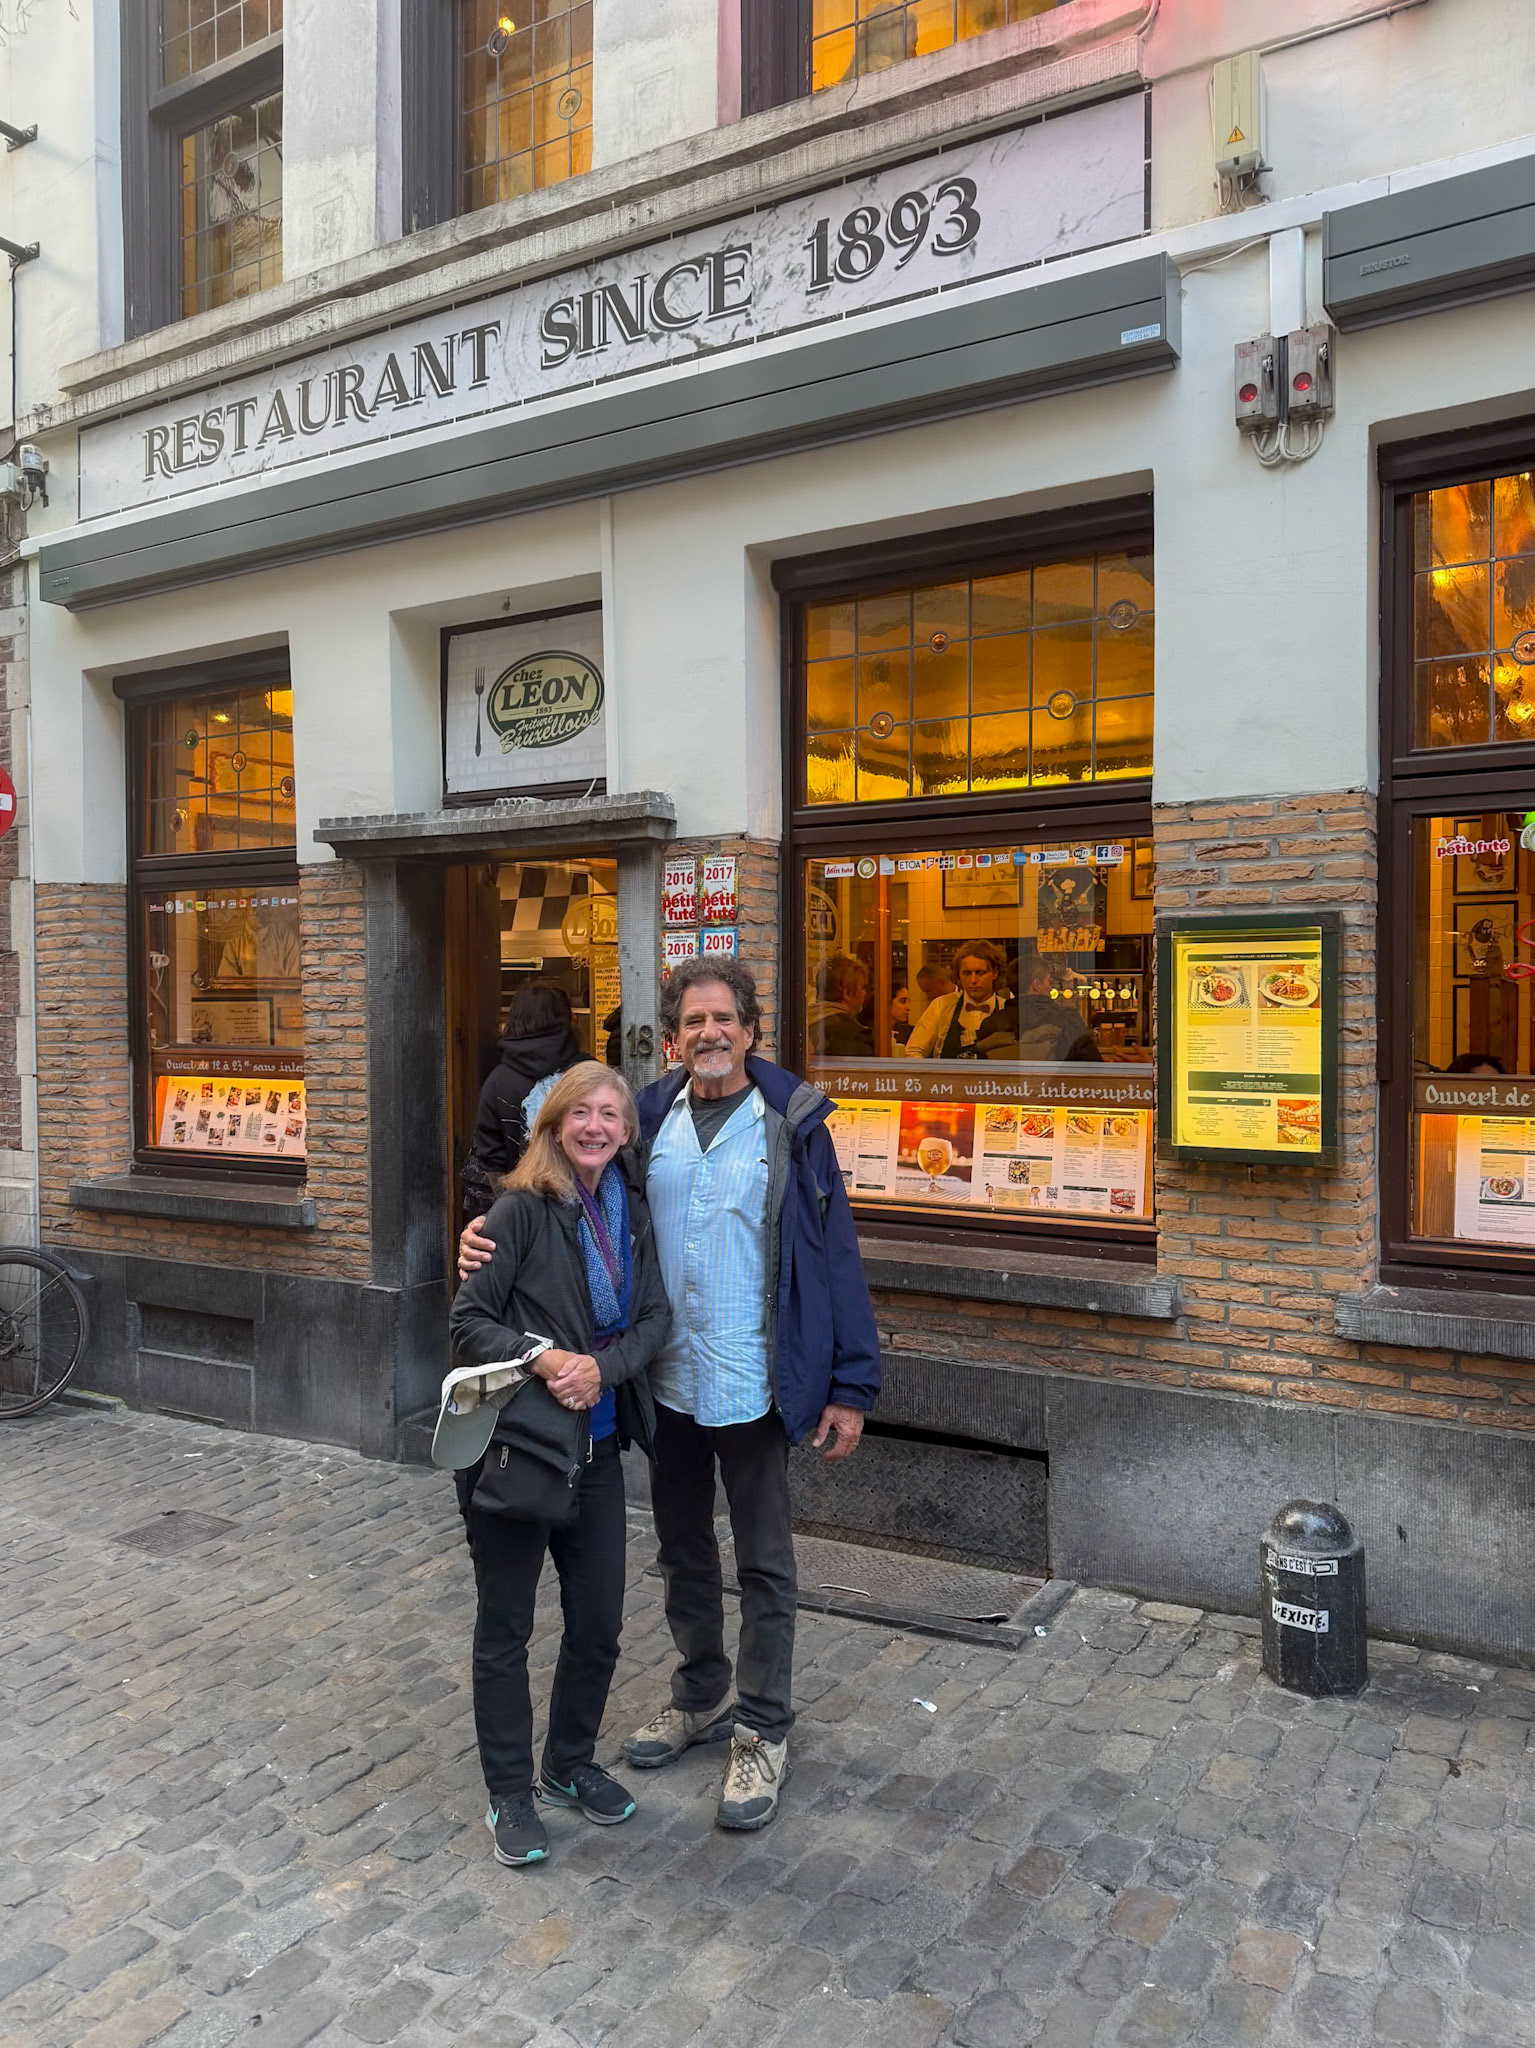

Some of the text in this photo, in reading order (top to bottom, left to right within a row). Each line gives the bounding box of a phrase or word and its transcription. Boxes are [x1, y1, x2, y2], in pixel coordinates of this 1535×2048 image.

[143, 177, 982, 483] RESTAURANT SINCE 1893
[513, 669, 543, 683] chez
[501, 672, 590, 711] LEON
[535, 706, 553, 715] 1893
[516, 715, 554, 735] Friture
[1437, 839, 1509, 858] petit futé
[705, 866, 733, 880] 2017
[899, 860, 921, 870] ETOA
[666, 872, 694, 886] 2016
[661, 894, 697, 913] petit
[701, 893, 737, 911] petit
[668, 908, 697, 920] futé
[707, 907, 737, 920] futé
[667, 942, 694, 956] 2018
[705, 935, 733, 951] 2019
[625, 1024, 653, 1057] 18
[197, 1060, 210, 1071] de
[212, 1060, 221, 1071] 12
[252, 1062, 276, 1072] sans
[874, 1077, 898, 1093] till
[905, 1078, 922, 1093] 23
[930, 1083, 953, 1095] AM
[964, 1080, 1034, 1097] without
[1425, 1084, 1533, 1107] Ouvert de
